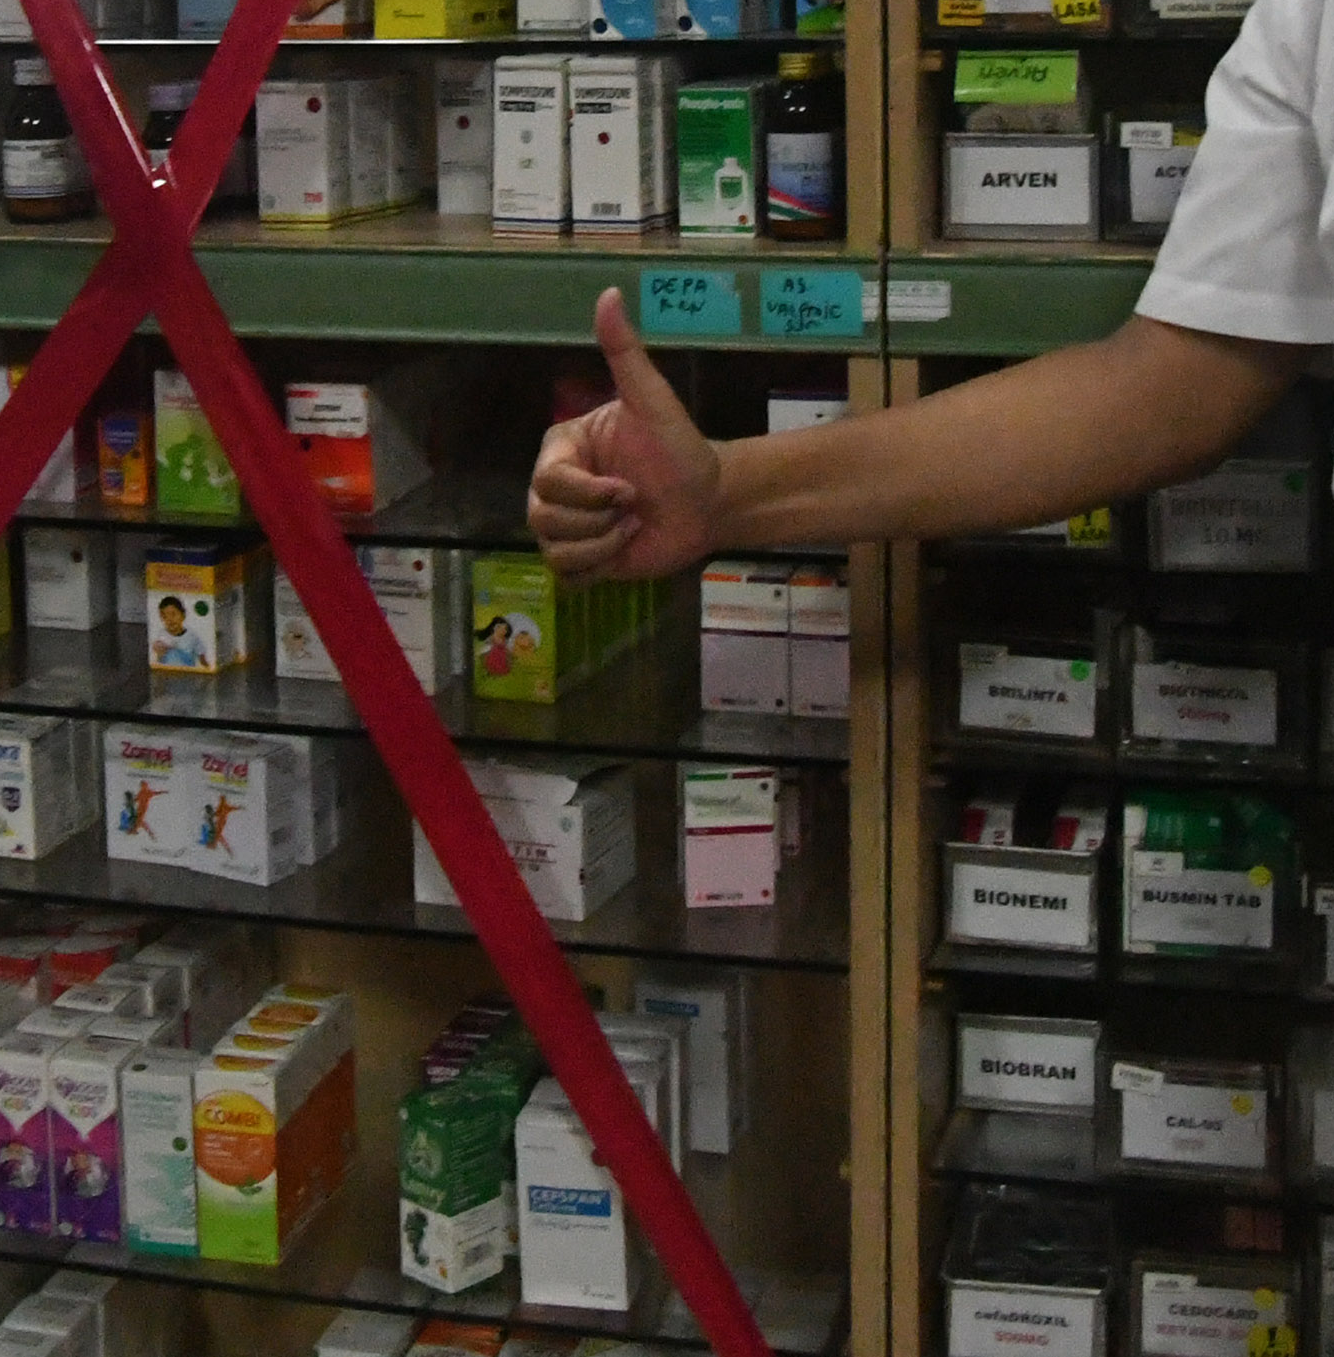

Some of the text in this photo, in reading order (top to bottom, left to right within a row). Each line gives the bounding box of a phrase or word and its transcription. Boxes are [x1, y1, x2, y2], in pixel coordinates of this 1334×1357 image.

[1053, 2, 1100, 18] LASA
[981, 171, 1058, 189] ARVEN
[973, 888, 1068, 911] BIONEMI
[1224, 892, 1263, 909] TAB
[980, 1058, 1077, 1081] BIOBRAN
[1167, 1303, 1259, 1321] CEDOCARD
